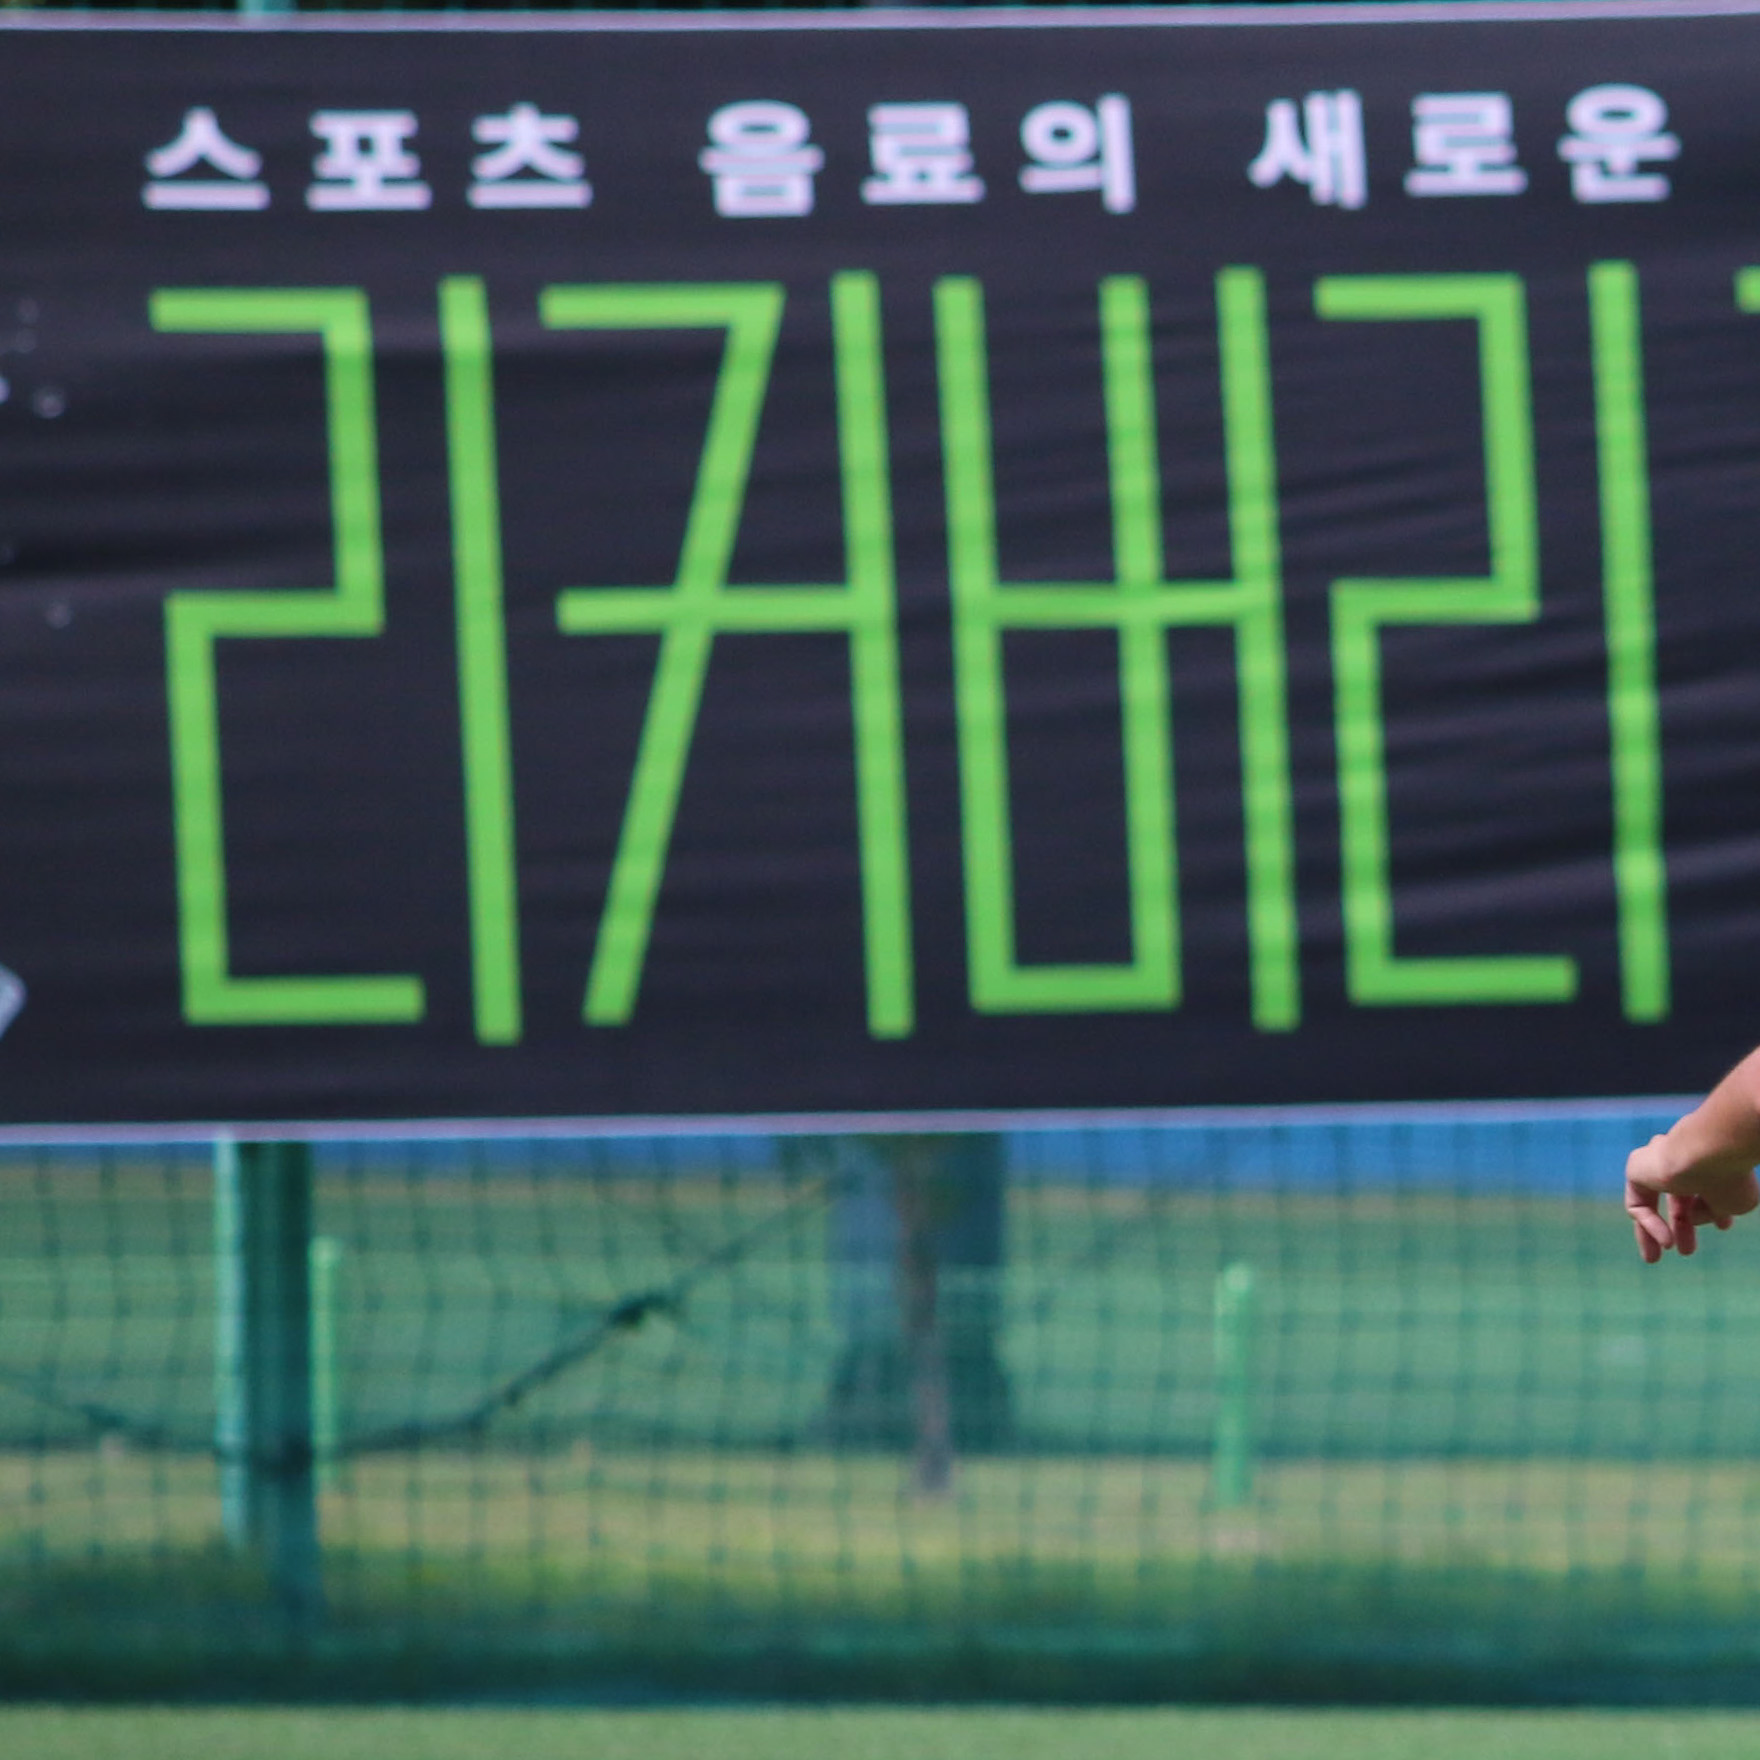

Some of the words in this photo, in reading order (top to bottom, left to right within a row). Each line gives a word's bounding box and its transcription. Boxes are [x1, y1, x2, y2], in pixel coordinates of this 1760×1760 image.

[145, 105, 591, 209] 스포츠
[701, 96, 1135, 216] 음료의
[1251, 87, 1678, 207] 새로운
